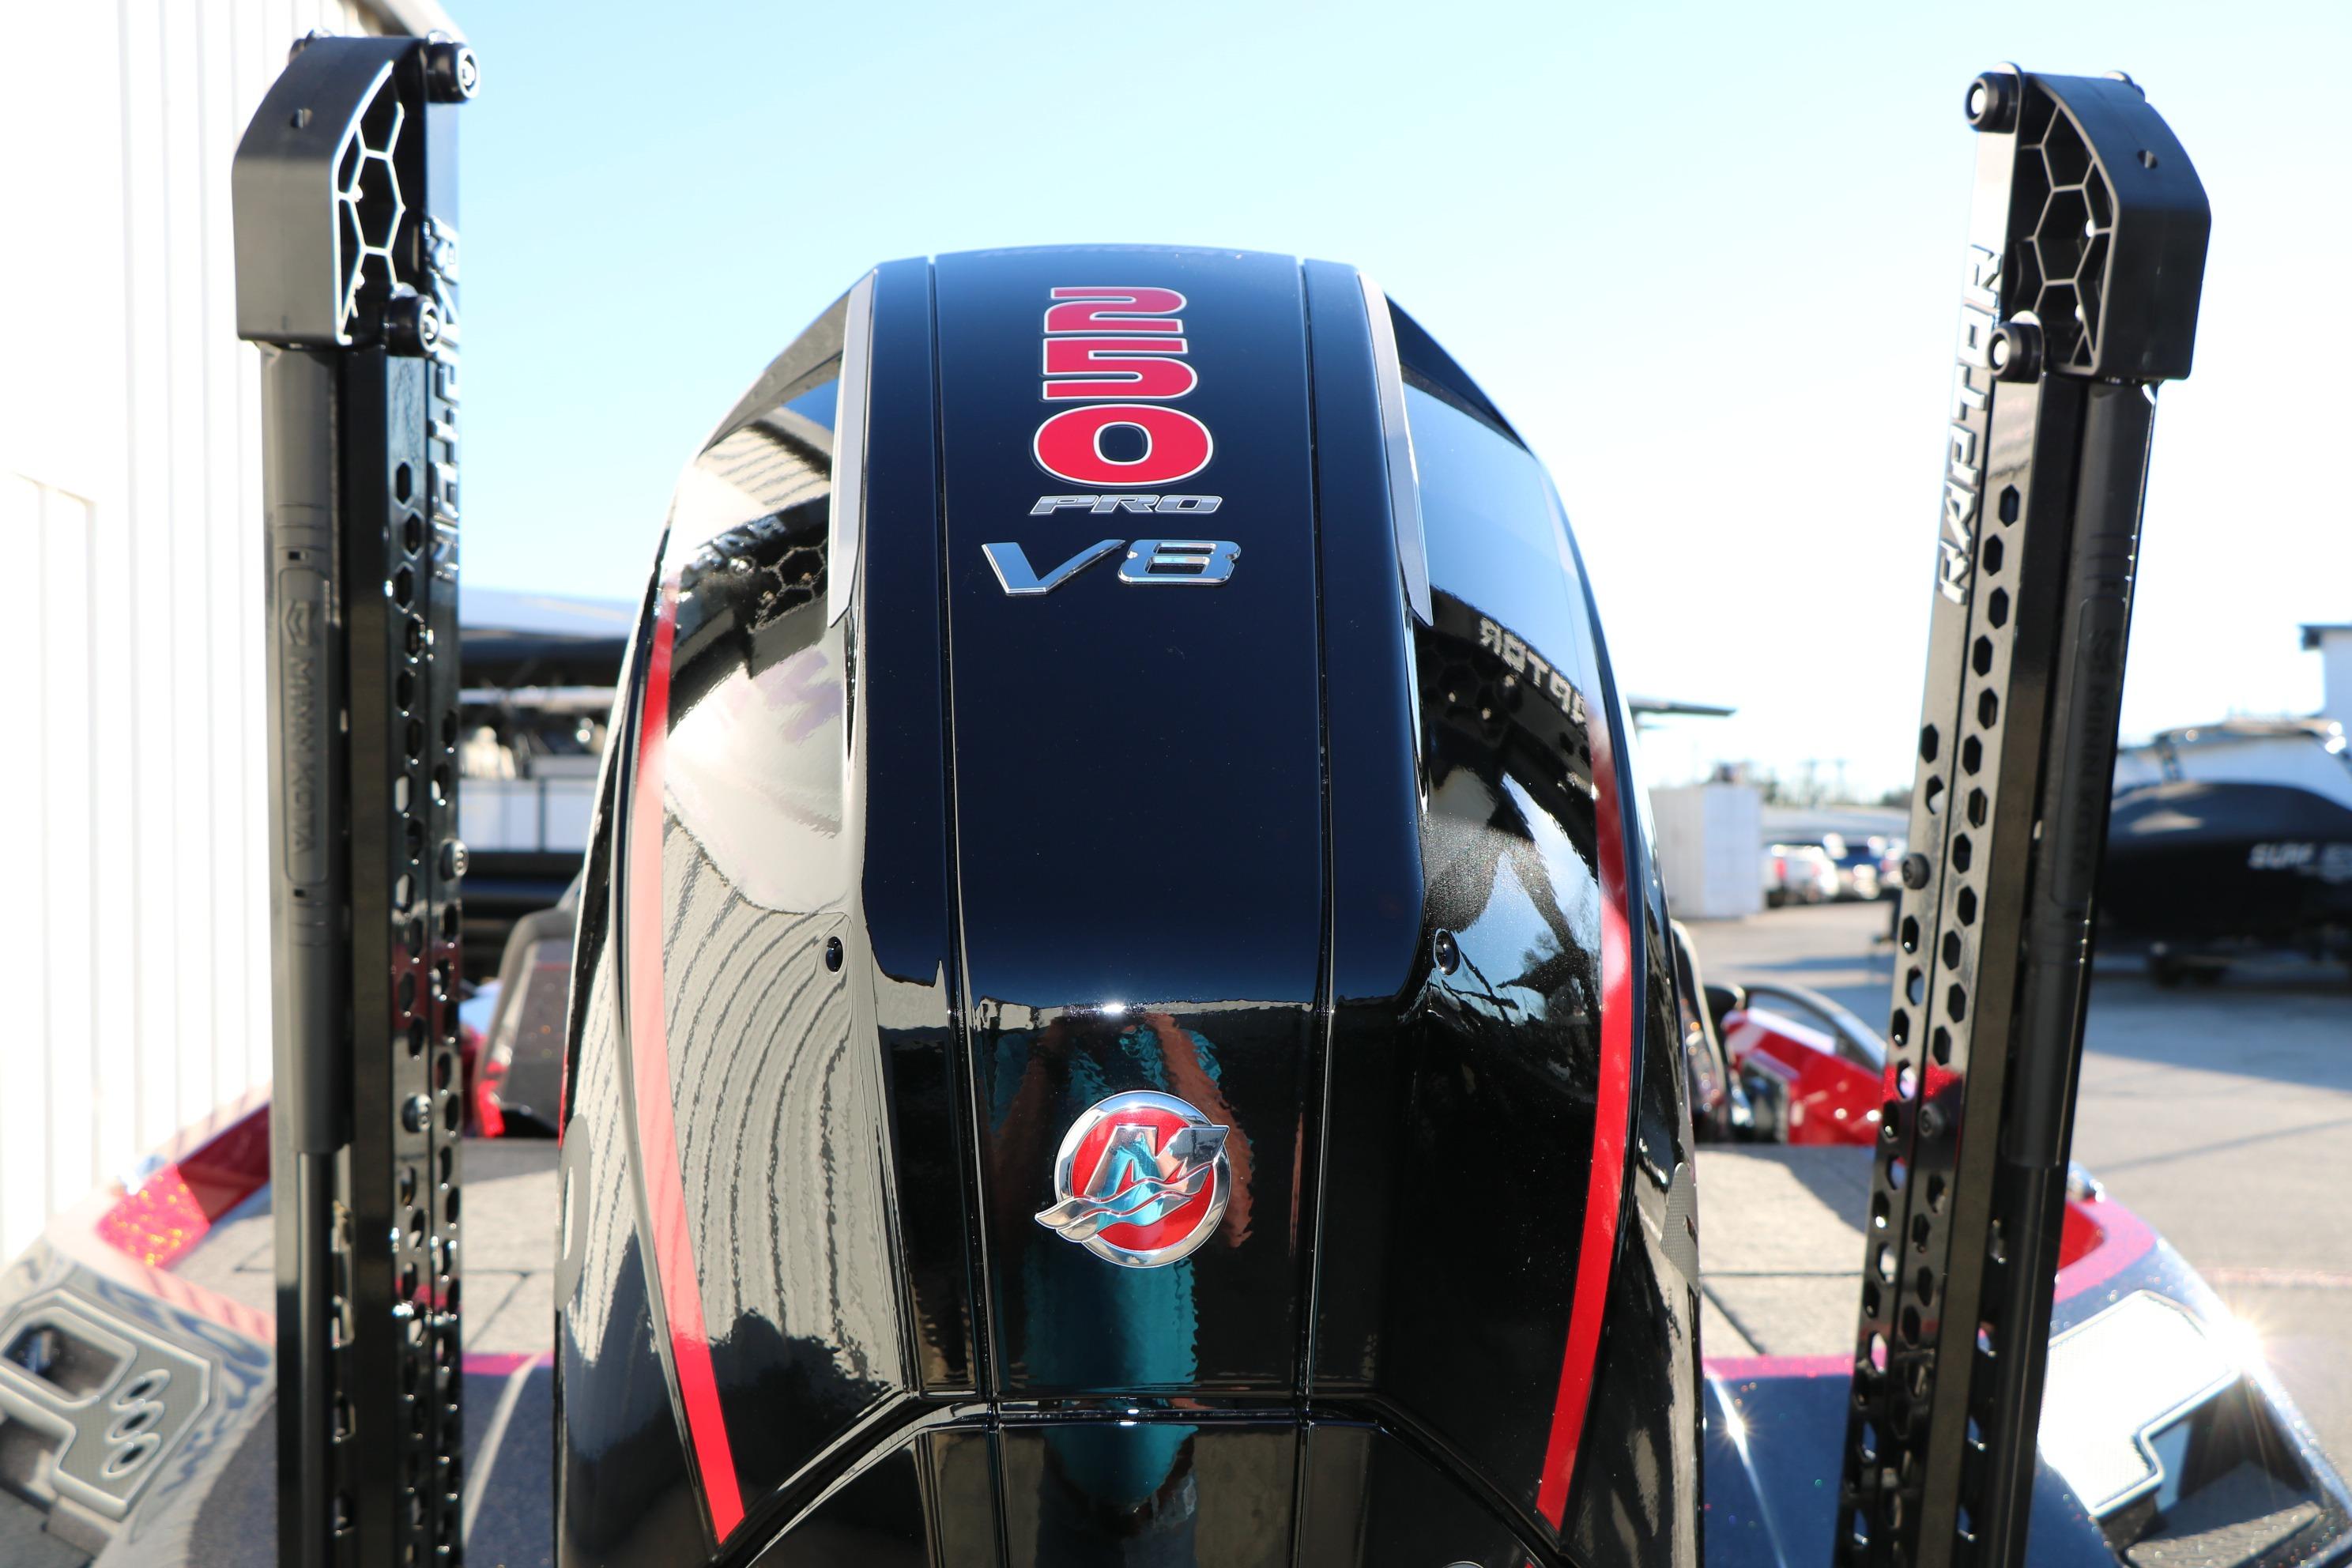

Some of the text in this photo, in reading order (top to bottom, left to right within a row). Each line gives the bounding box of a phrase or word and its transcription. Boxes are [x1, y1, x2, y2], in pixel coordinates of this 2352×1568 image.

[1034, 287, 1214, 487] 250
[1939, 243, 2003, 605] RAPTOR
[981, 539, 1242, 596] V8
[1029, 495, 1223, 514] PRO
[288, 656, 316, 854] MINN KOTA
